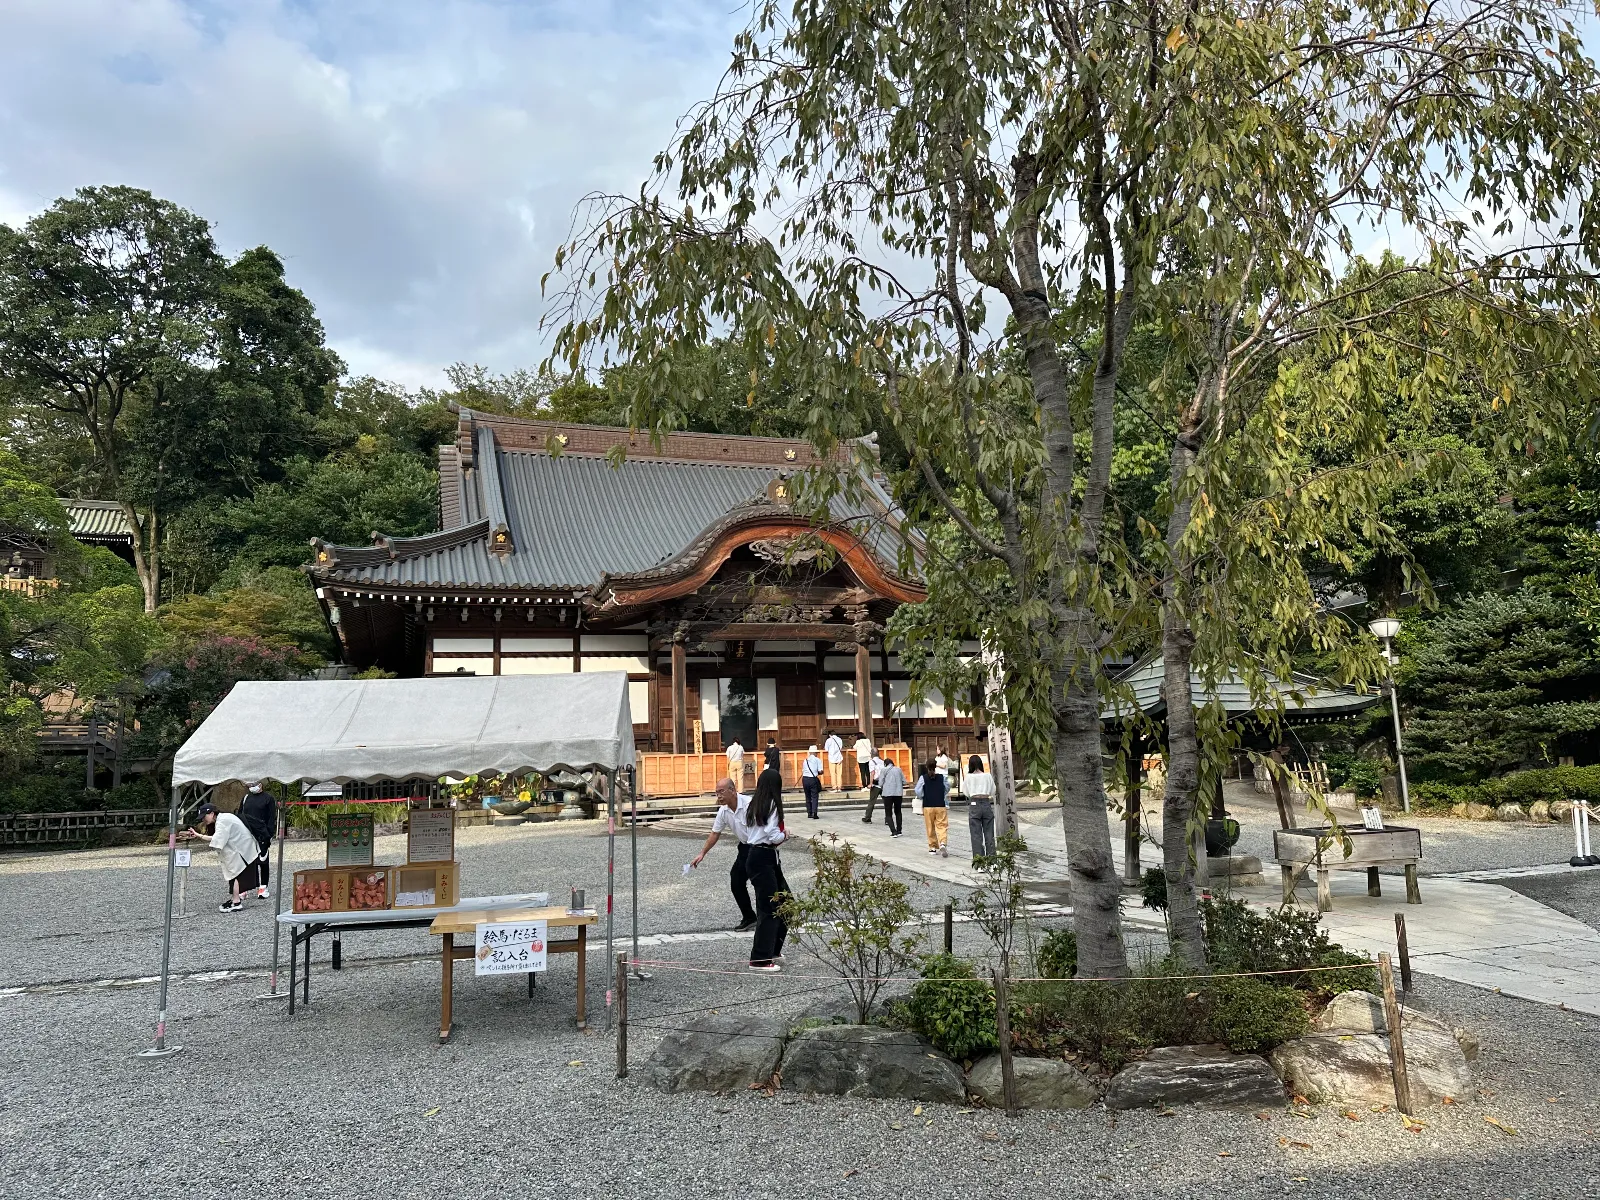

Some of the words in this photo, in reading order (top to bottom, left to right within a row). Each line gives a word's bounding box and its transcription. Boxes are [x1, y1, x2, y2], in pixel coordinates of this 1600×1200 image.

[337, 878, 345, 904] おみくじ
[441, 873, 449, 900] おみくじ
[490, 948, 529, 963] 記入台
